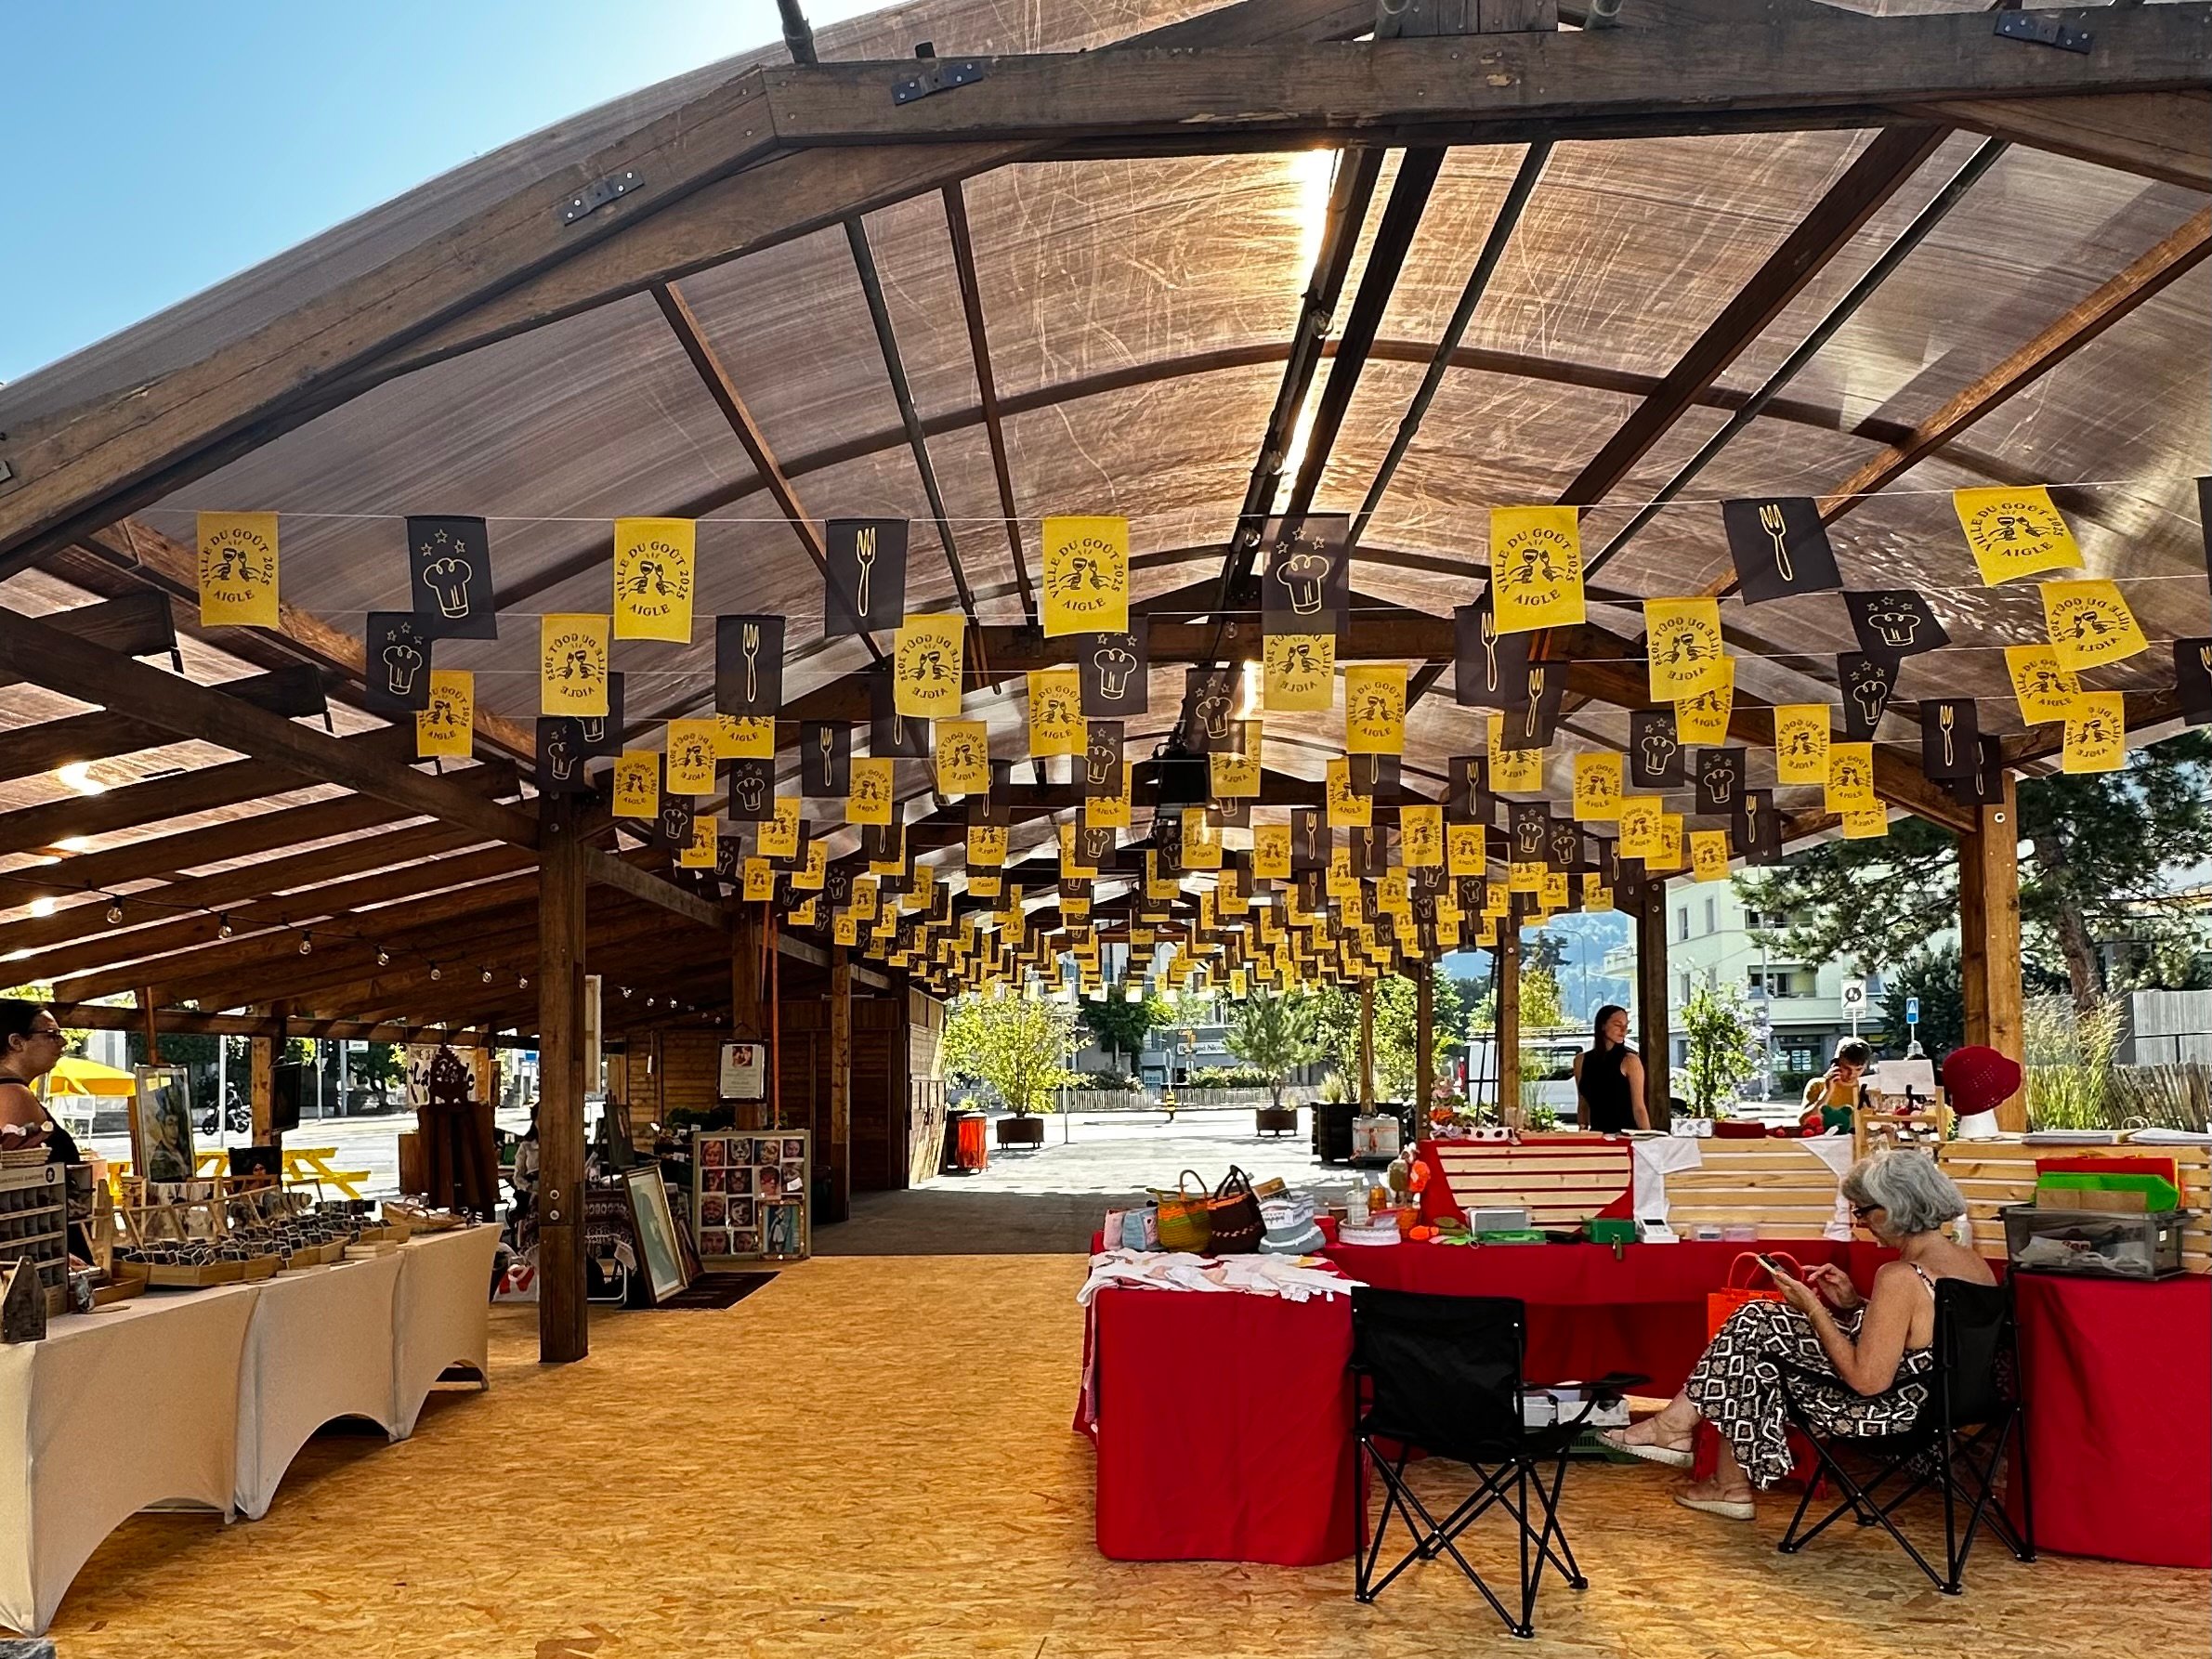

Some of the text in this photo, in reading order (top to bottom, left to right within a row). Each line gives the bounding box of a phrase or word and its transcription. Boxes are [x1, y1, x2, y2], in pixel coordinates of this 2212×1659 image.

[201, 529, 274, 587] VILLE DU GOÛT 2025
[617, 542, 689, 602] VILLE DU GOÛT 2025
[1047, 538, 1124, 598] VILLE DU GOÛT 2025
[1496, 529, 1577, 594] VILLE DU GOÛT 2025
[213, 590, 255, 602] AIGLE
[629, 604, 671, 616] AIGLE
[1062, 597, 1106, 611] AIGLE
[1513, 589, 1561, 606] AIGLE
